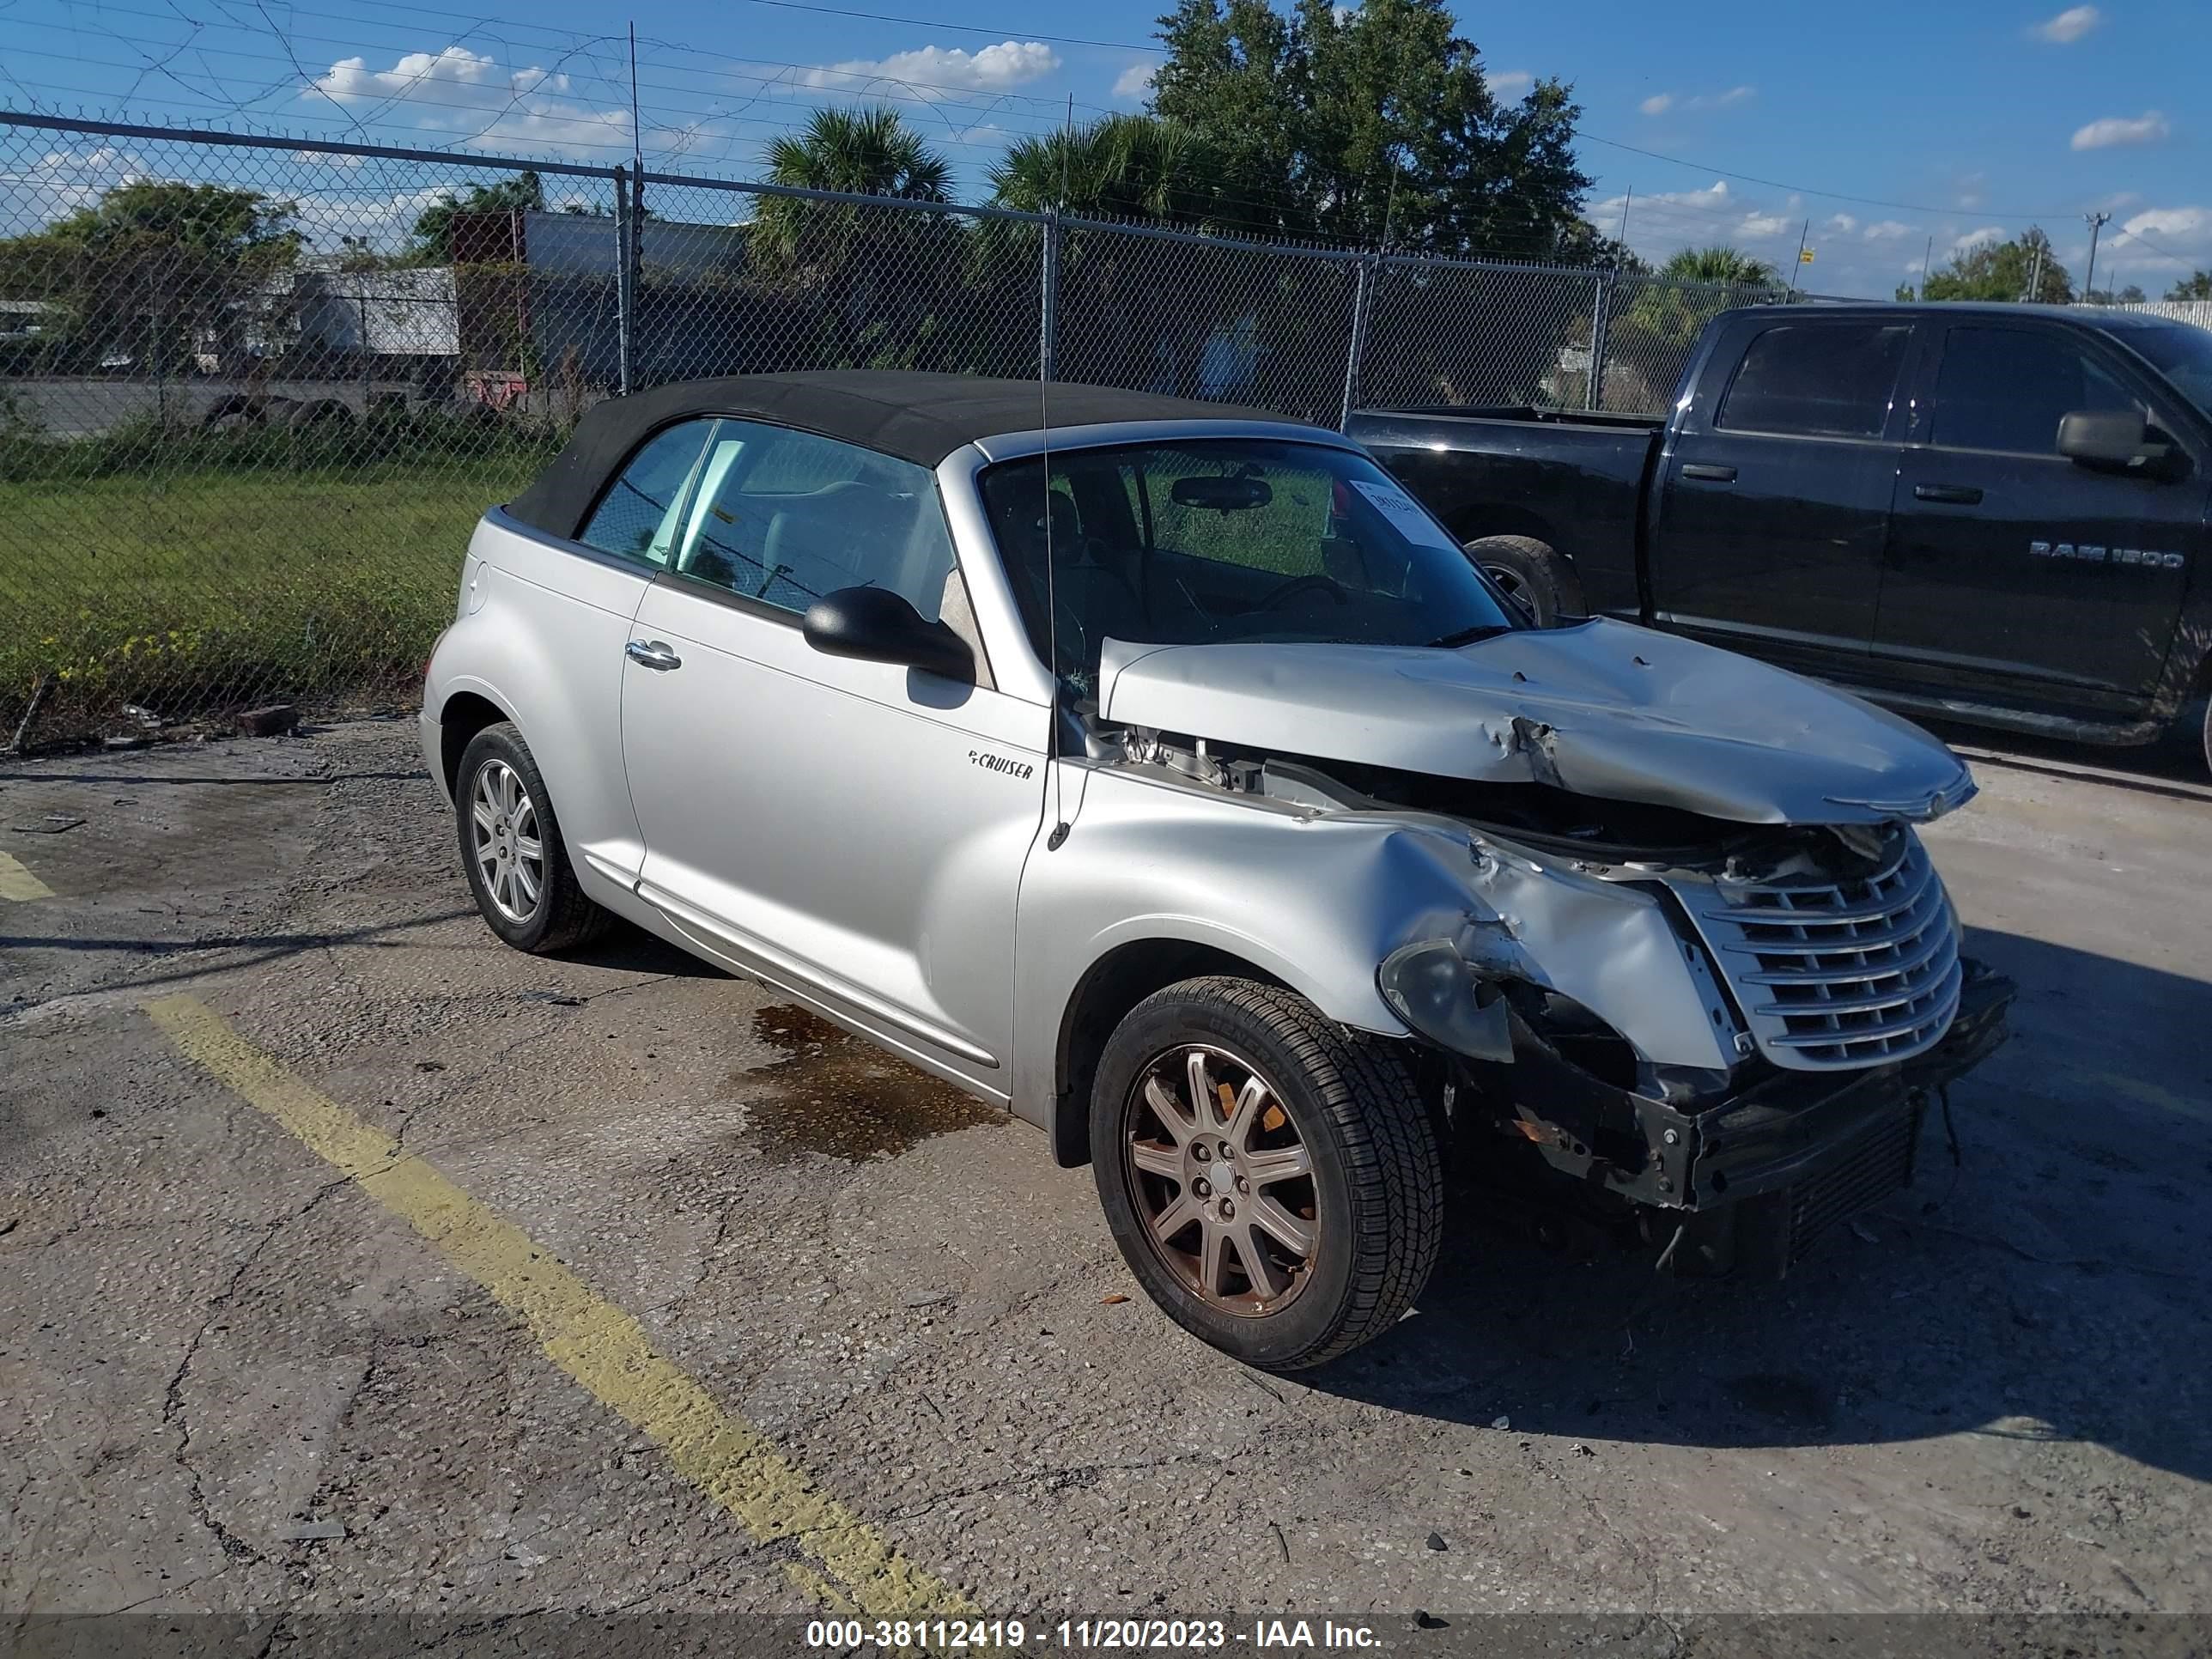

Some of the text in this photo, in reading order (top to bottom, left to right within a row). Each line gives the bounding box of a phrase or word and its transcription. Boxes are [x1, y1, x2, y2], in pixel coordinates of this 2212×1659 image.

[2029, 541, 2185, 568] RAM 1500
[978, 753, 1034, 780] CRUISER
[1208, 1015, 1293, 1089] GENERAL
